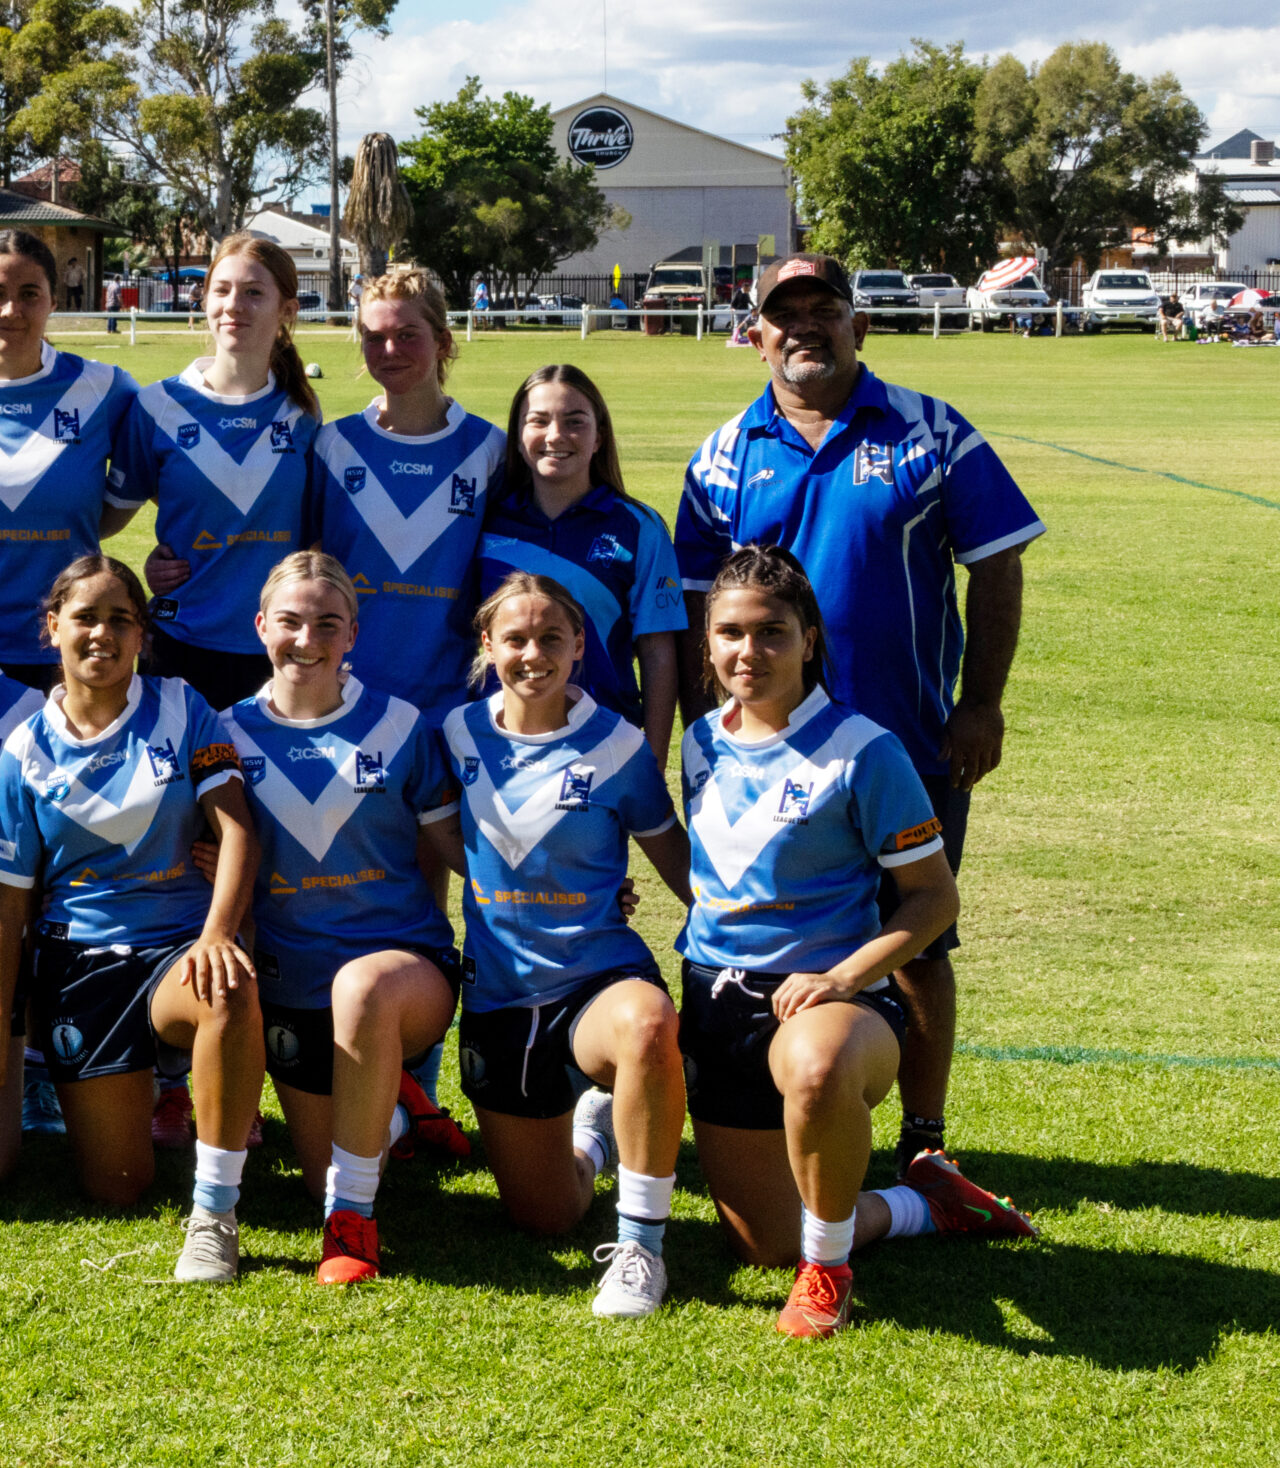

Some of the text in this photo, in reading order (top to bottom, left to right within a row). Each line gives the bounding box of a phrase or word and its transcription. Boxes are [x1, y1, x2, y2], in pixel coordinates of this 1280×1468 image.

[573, 125, 625, 150] Thrive
[2, 403, 32, 415] CSM
[232, 418, 257, 429] CSM
[180, 426, 197, 434] NSW
[403, 462, 433, 475] CSM
[303, 746, 335, 758] CSM
[773, 815, 796, 825] LEAGUE
[301, 869, 386, 889] SPECIALISED
[494, 890, 586, 905] SPECIALISED
